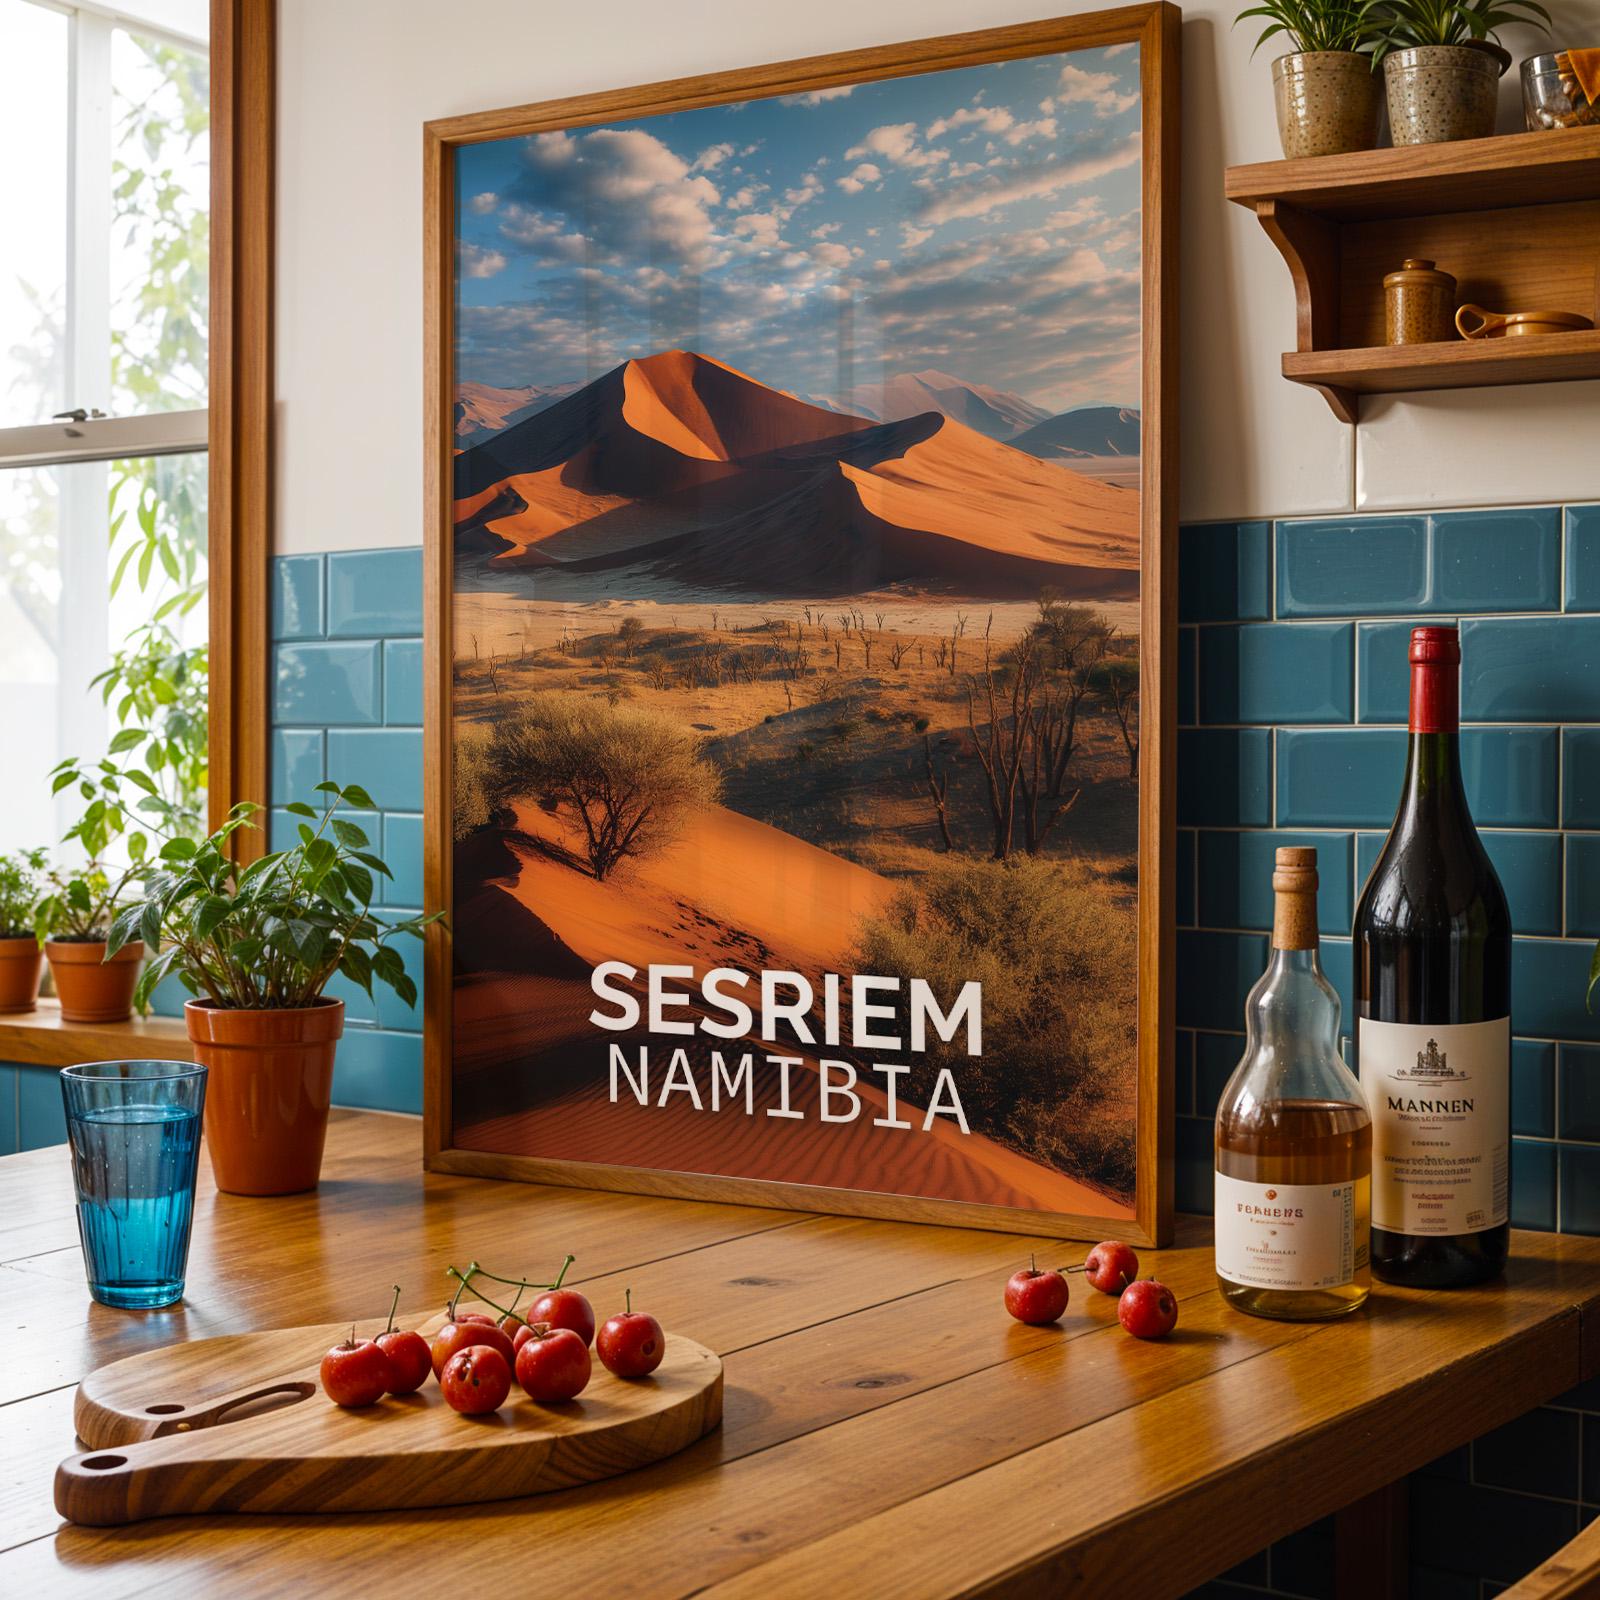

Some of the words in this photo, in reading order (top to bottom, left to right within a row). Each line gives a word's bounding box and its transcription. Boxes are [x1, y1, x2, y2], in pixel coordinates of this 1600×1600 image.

[588, 960, 983, 1057] SESRIEM
[609, 1043, 971, 1135] NAMIBIA
[1388, 1096, 1475, 1113] MANNEN
